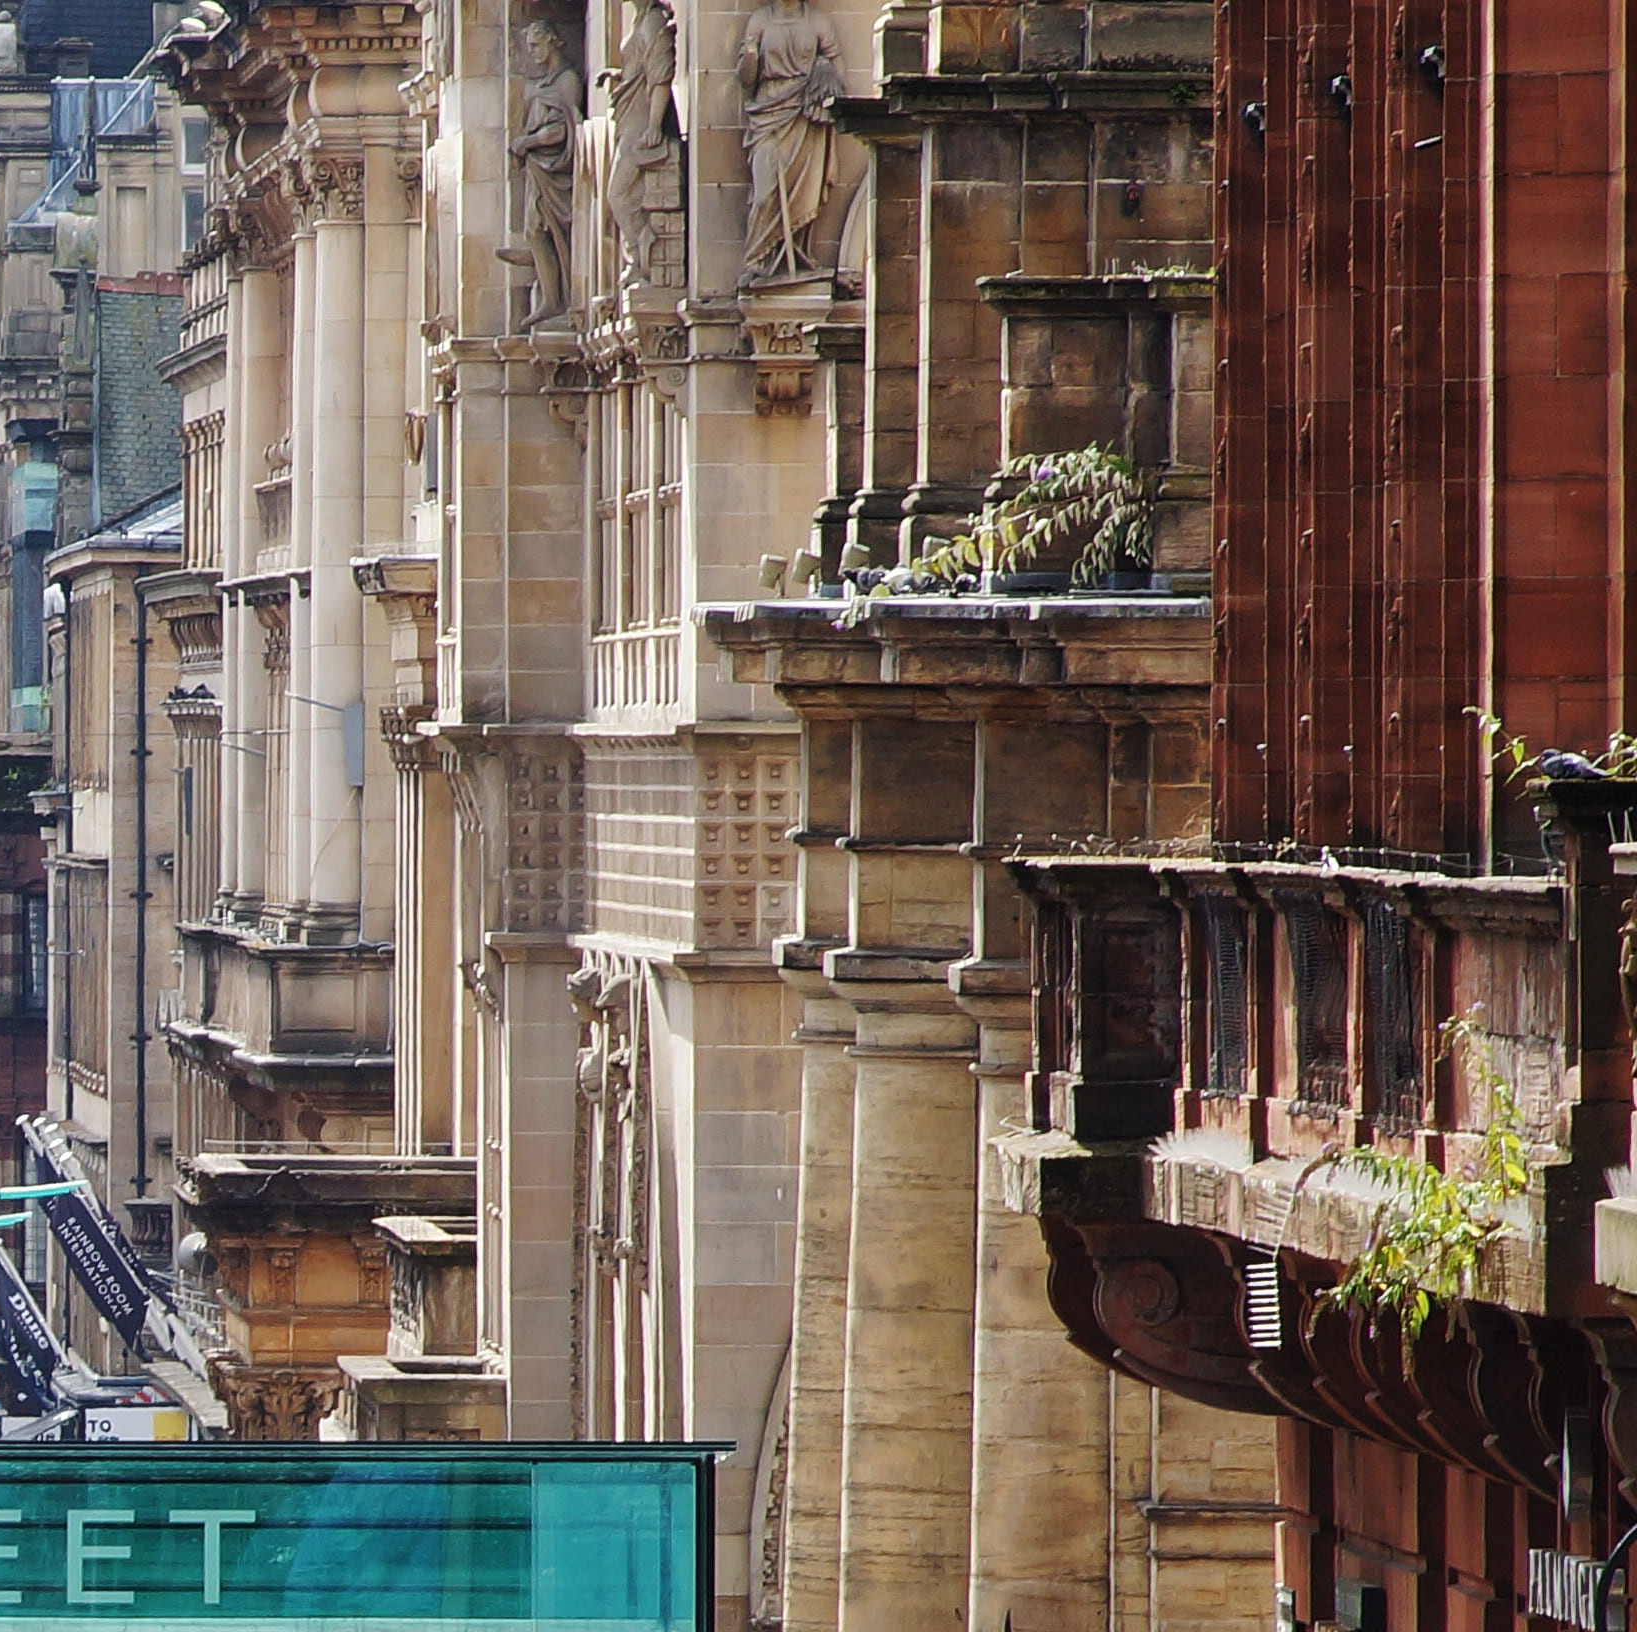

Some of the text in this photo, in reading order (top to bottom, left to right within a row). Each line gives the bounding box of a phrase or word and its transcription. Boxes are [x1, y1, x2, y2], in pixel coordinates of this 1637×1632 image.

[57, 1223, 122, 1320] INTERNATIONAL
[67, 1217, 110, 1273] RAINBOW
[106, 1275, 134, 1316] ROOM
[9, 1292, 49, 1350] Dune
[88, 1420, 111, 1433] TO
